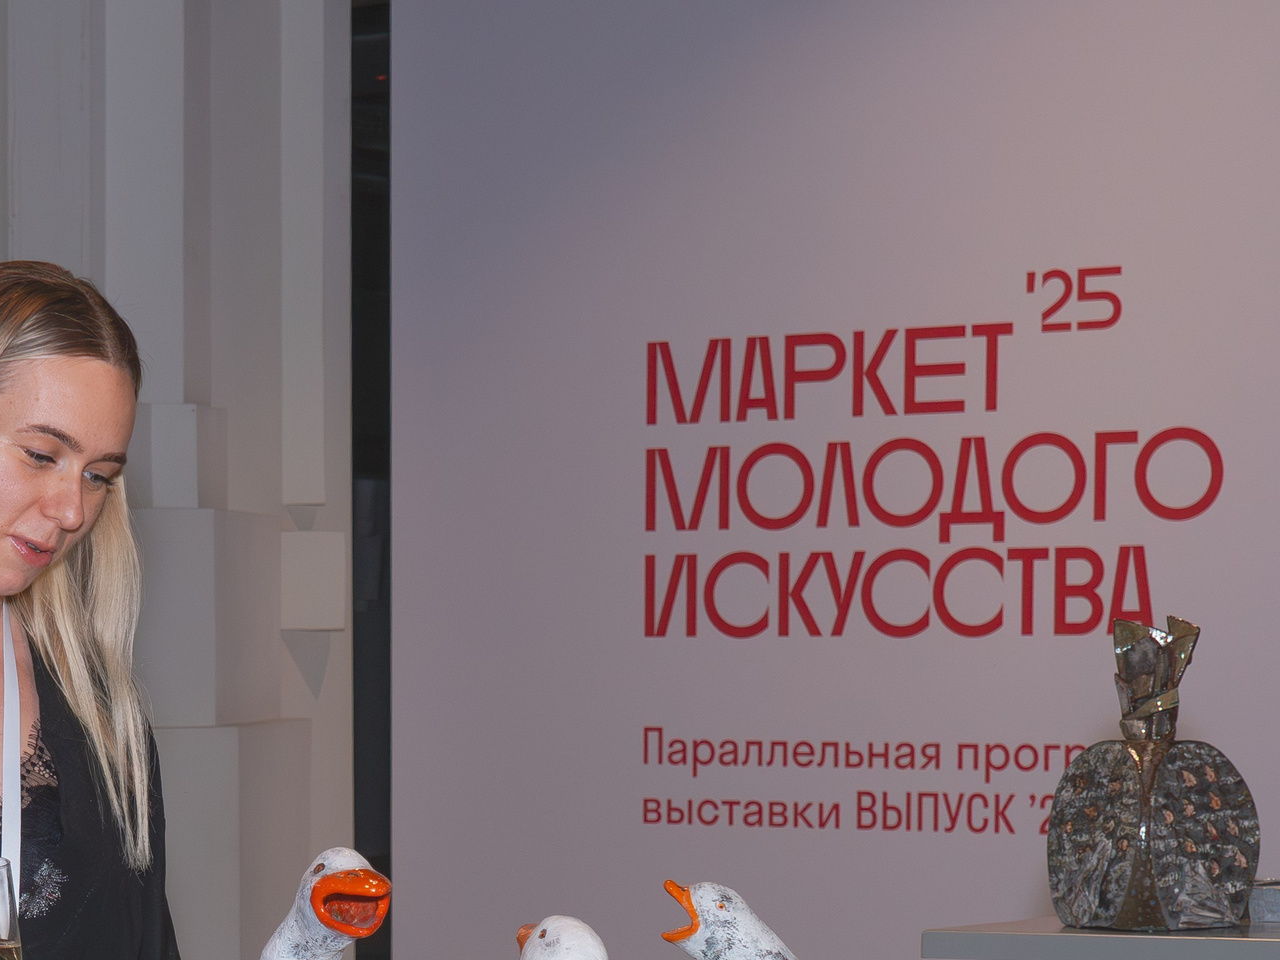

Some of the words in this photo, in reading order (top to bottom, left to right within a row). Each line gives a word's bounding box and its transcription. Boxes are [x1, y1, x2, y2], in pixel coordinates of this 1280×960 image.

[1026, 265, 1123, 333] '25
[646, 322, 1014, 425] МАРКЕТ
[645, 427, 1224, 543] МОЛОДОГО
[645, 545, 1154, 638] ИСКУССТВА
[643, 727, 941, 777] Параллельная
[643, 797, 841, 830] выставки
[857, 791, 1016, 835] ВЫПУСК
